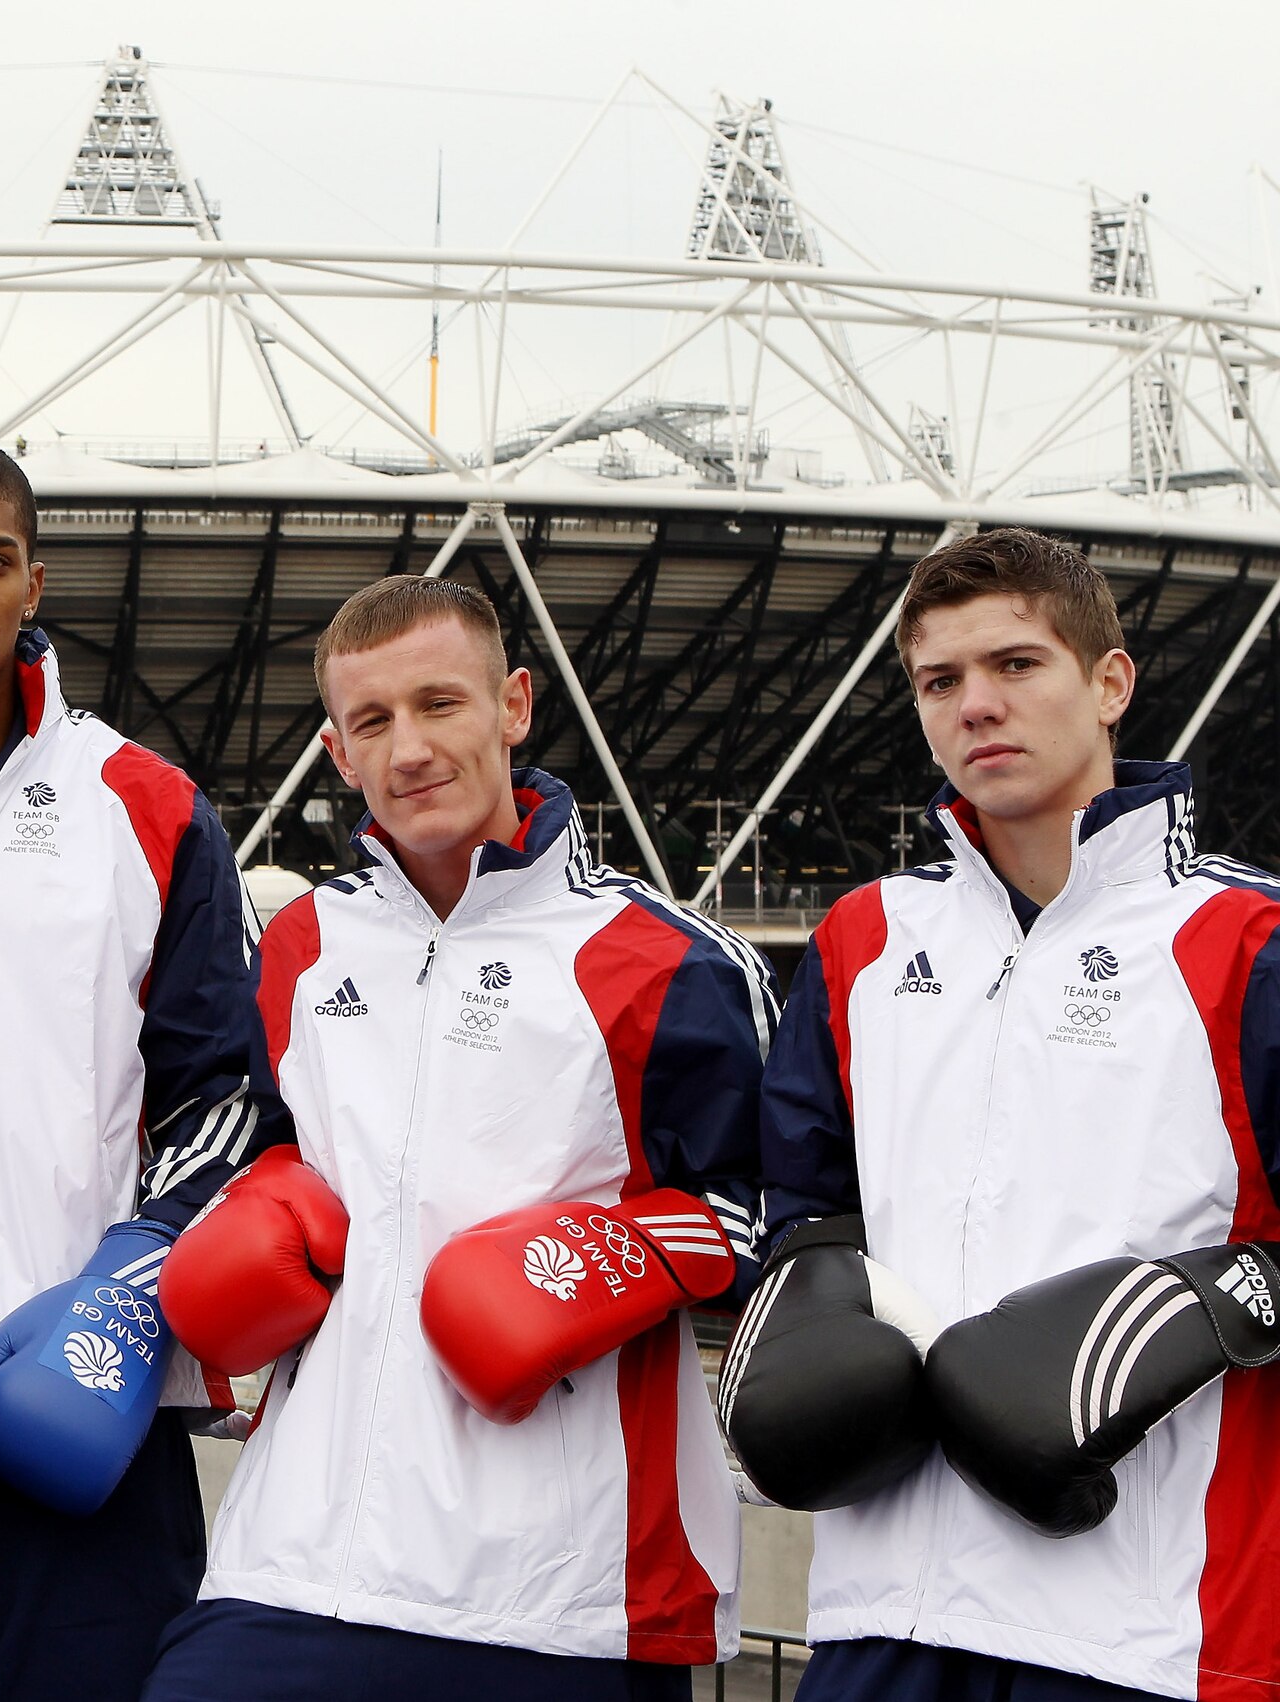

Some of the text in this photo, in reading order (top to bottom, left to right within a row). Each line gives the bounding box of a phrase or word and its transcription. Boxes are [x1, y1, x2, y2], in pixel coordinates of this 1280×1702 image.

[13, 811, 60, 822] TEAM GB
[29, 847, 61, 858] SELECTION
[40, 841, 56, 849] 2012
[894, 978, 942, 997] adidas
[1063, 985, 1121, 1002] TEAM GB
[461, 990, 509, 1009] TEAM GB
[314, 1003, 368, 1017] adidas
[451, 1027, 498, 1043] LONDON 2012
[1056, 1025, 1111, 1039] LONDON 2012
[442, 1034, 502, 1052] ATHLETE SELECTION
[1046, 1033, 1117, 1048] ATHLETE SELECTION
[556, 1216, 627, 1298] TEAM GB
[1237, 1254, 1275, 1326] adidas
[71, 1301, 154, 1366] TEAM GB
